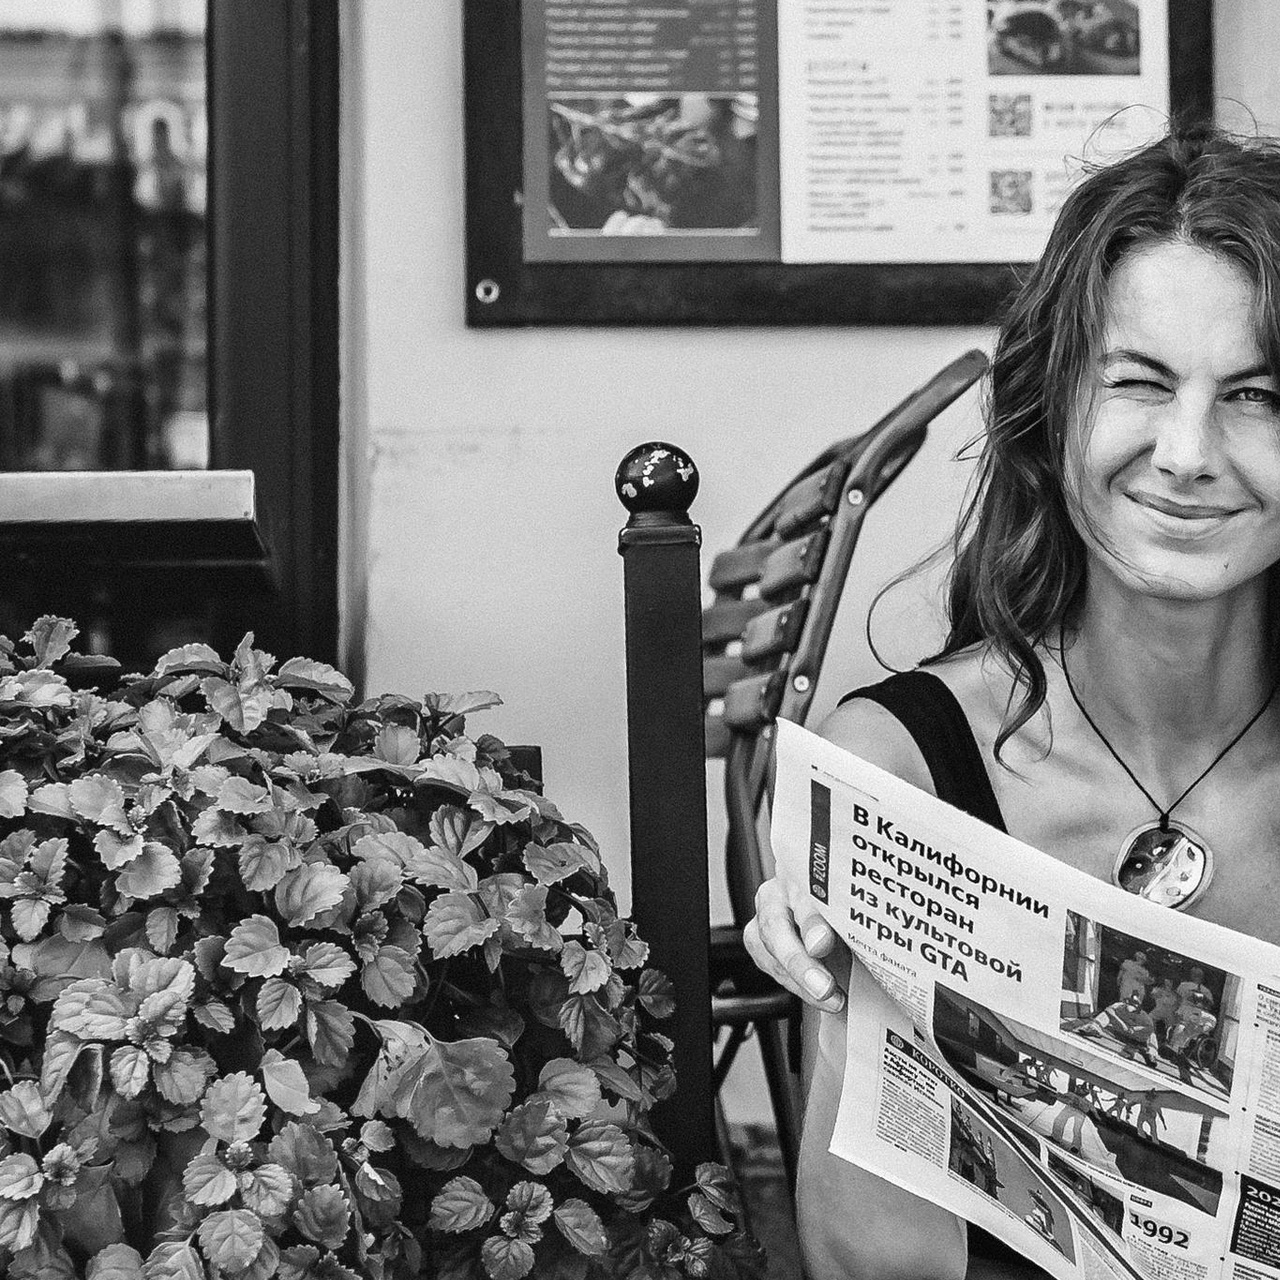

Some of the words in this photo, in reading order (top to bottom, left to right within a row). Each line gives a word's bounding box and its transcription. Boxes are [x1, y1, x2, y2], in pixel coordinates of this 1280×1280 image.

[851, 857, 974, 934] ресторан
[852, 834, 980, 910] открылся
[853, 803, 869, 827] В
[877, 815, 1050, 919] Калифорнии
[848, 932, 878, 956] Мечта
[880, 953, 917, 978] фаната
[850, 883, 878, 909] из
[886, 902, 1023, 983] культовой
[850, 907, 912, 952] игры
[920, 942, 969, 983] GTA
[1130, 1211, 1189, 1250] 1992
